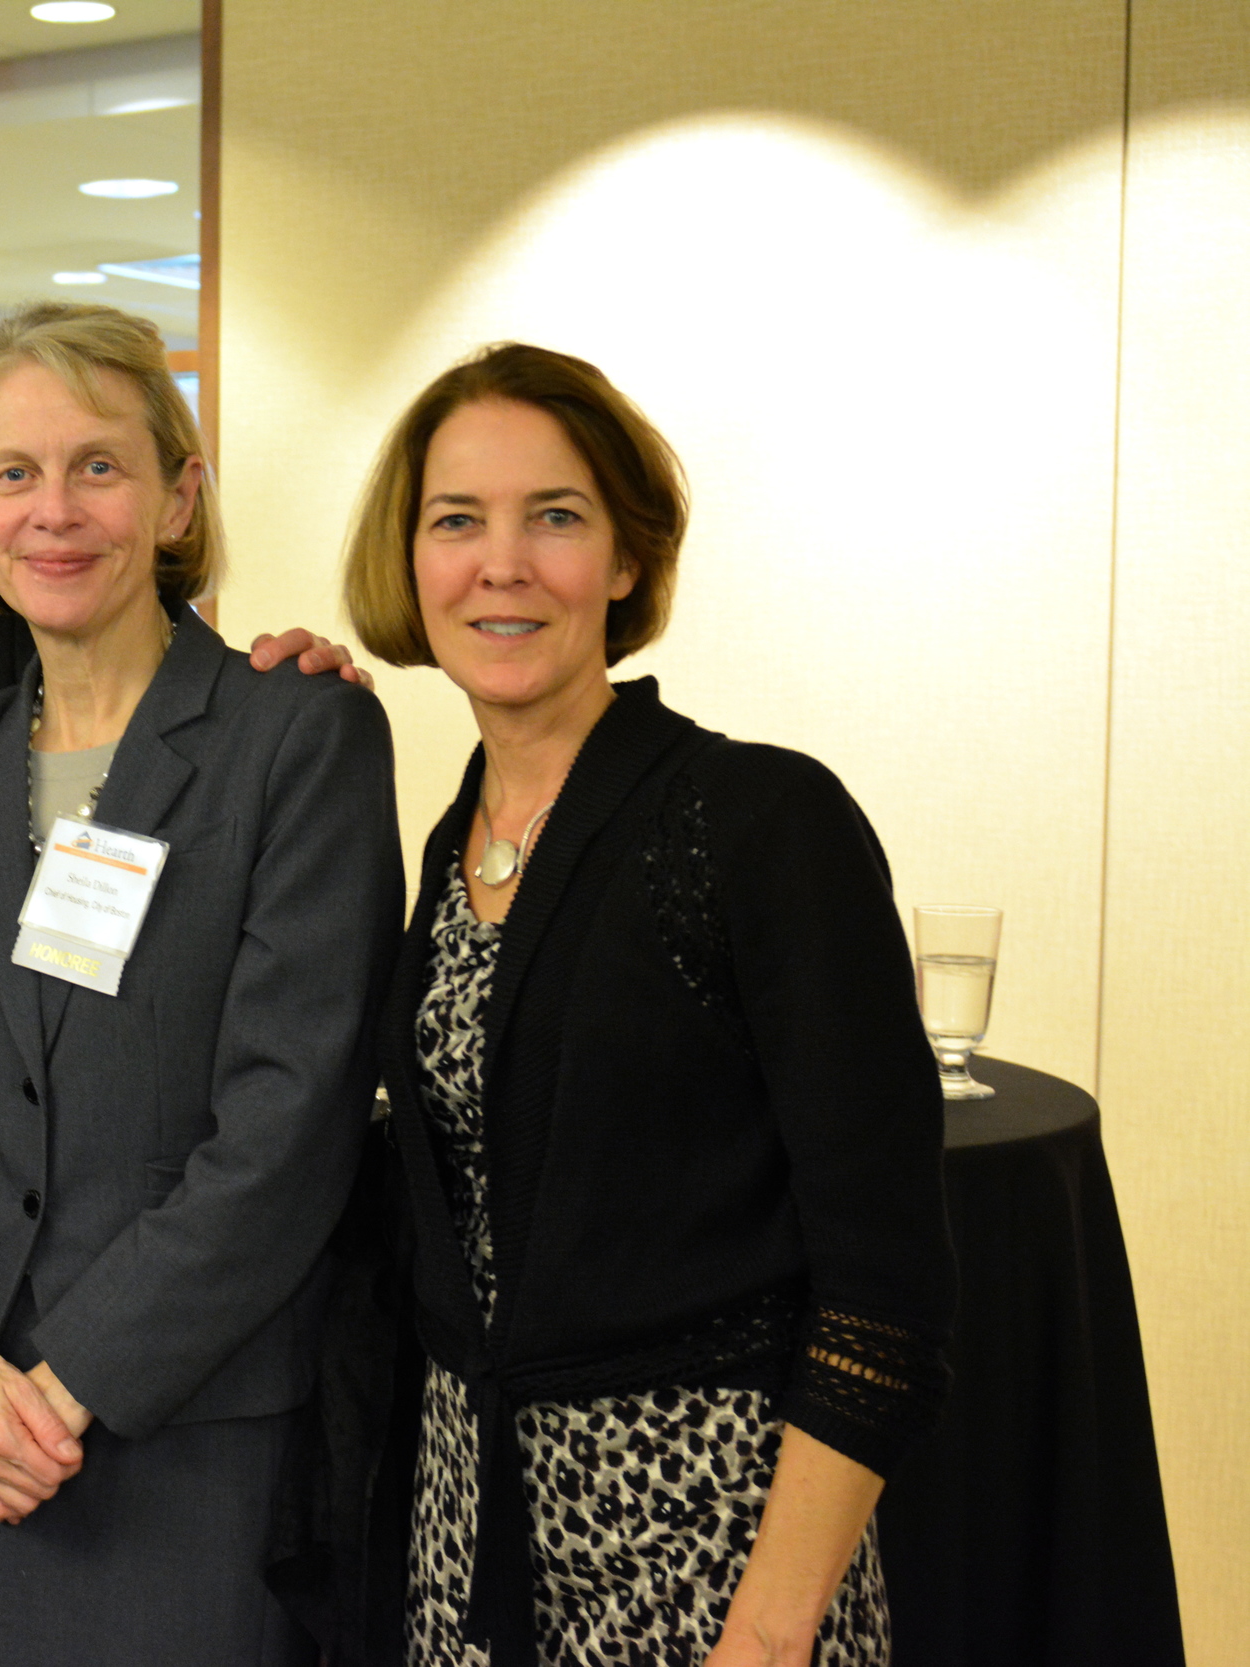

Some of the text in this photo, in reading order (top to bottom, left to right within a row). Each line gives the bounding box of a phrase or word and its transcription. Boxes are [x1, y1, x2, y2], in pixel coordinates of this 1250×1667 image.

[94, 838, 136, 862] Hearth
[66, 872, 119, 896] Sheila Dillon
[29, 942, 102, 977] HONOREE
